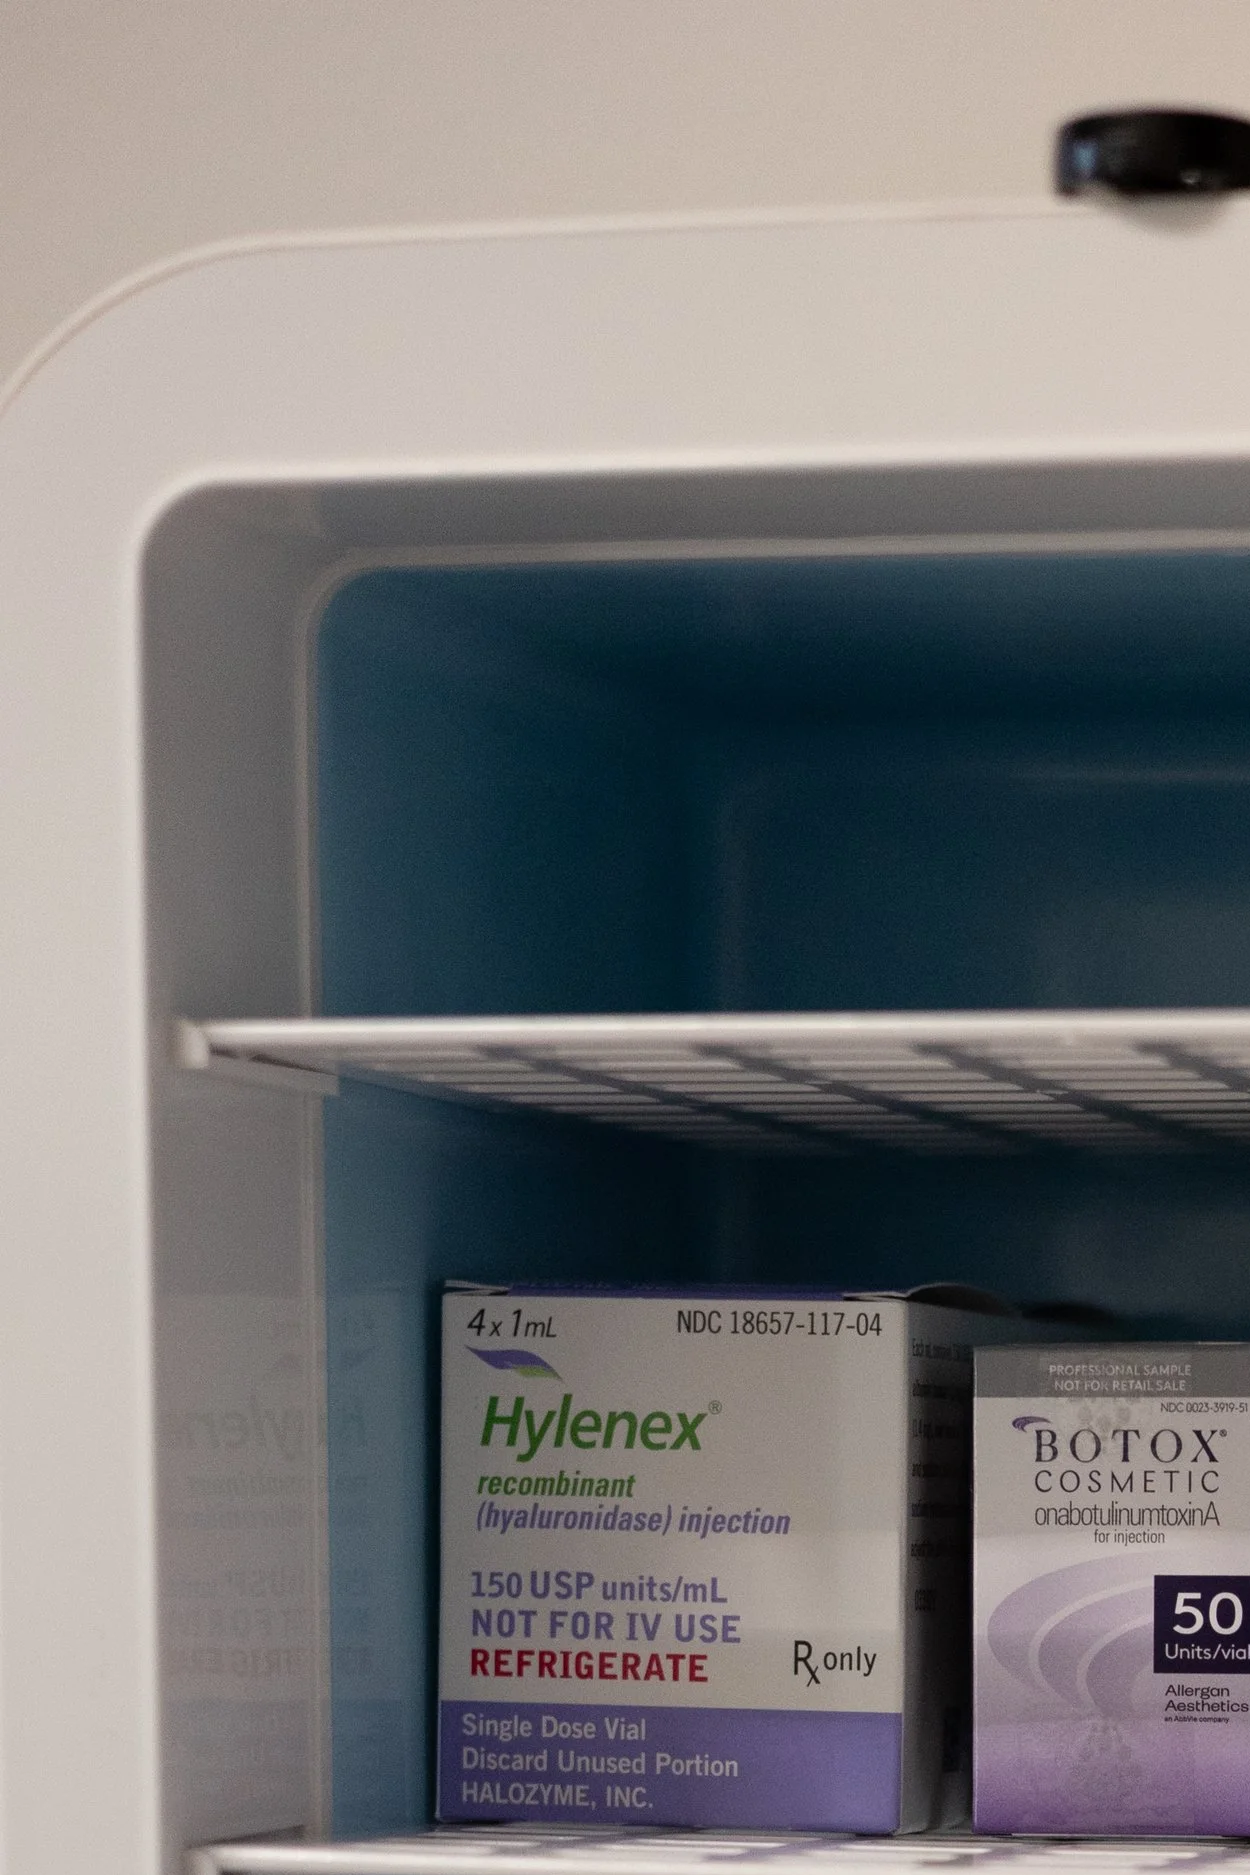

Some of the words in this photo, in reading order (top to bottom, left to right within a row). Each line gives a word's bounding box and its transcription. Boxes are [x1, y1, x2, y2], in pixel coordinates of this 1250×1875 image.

[467, 1308, 486, 1337] 4
[489, 1319, 502, 1337] x
[510, 1309, 558, 1338] 1mL
[677, 1309, 722, 1335] NDC
[730, 1311, 883, 1337] 18657-117-04
[1049, 1364, 1140, 1377] PROFESSIONAL
[1143, 1364, 1192, 1377] SAMPLE
[1054, 1380, 1082, 1392] NOT
[1084, 1380, 1110, 1392] FOR
[1112, 1380, 1154, 1392] RETAIL
[1156, 1380, 1186, 1392] SALE
[1160, 1402, 1184, 1413] NDC
[1186, 1402, 1249, 1414] 0023-3919-51
[477, 1472, 636, 1499] recombinant
[1034, 1470, 1220, 1493] COSMETIC
[476, 1503, 673, 1537] (hyaluronidase)
[678, 1508, 791, 1539] injection
[1034, 1500, 1221, 1526] onabotulinumtoxinA
[1094, 1529, 1110, 1544] for
[1114, 1529, 1166, 1546] injection
[470, 1571, 523, 1600] 150
[530, 1570, 595, 1602] USP
[601, 1574, 728, 1604] units/mL
[471, 1610, 536, 1639] NOT
[549, 1611, 614, 1641] FOR
[627, 1613, 662, 1642] IV
[674, 1614, 742, 1644] USE
[1172, 1591, 1244, 1636] 50
[470, 1648, 709, 1684] REFRIGERATE
[823, 1647, 877, 1677] only
[1164, 1684, 1230, 1700] Allergan
[1164, 1699, 1250, 1713] Aesthetics
[462, 1713, 533, 1742] Single
[541, 1716, 597, 1740] Dose
[604, 1717, 647, 1741] Vial
[462, 1747, 548, 1773] Discard
[557, 1749, 647, 1776] Unused
[655, 1753, 739, 1778] Portion
[462, 1782, 597, 1810] HALOZYME,
[605, 1786, 654, 1810] INC.
